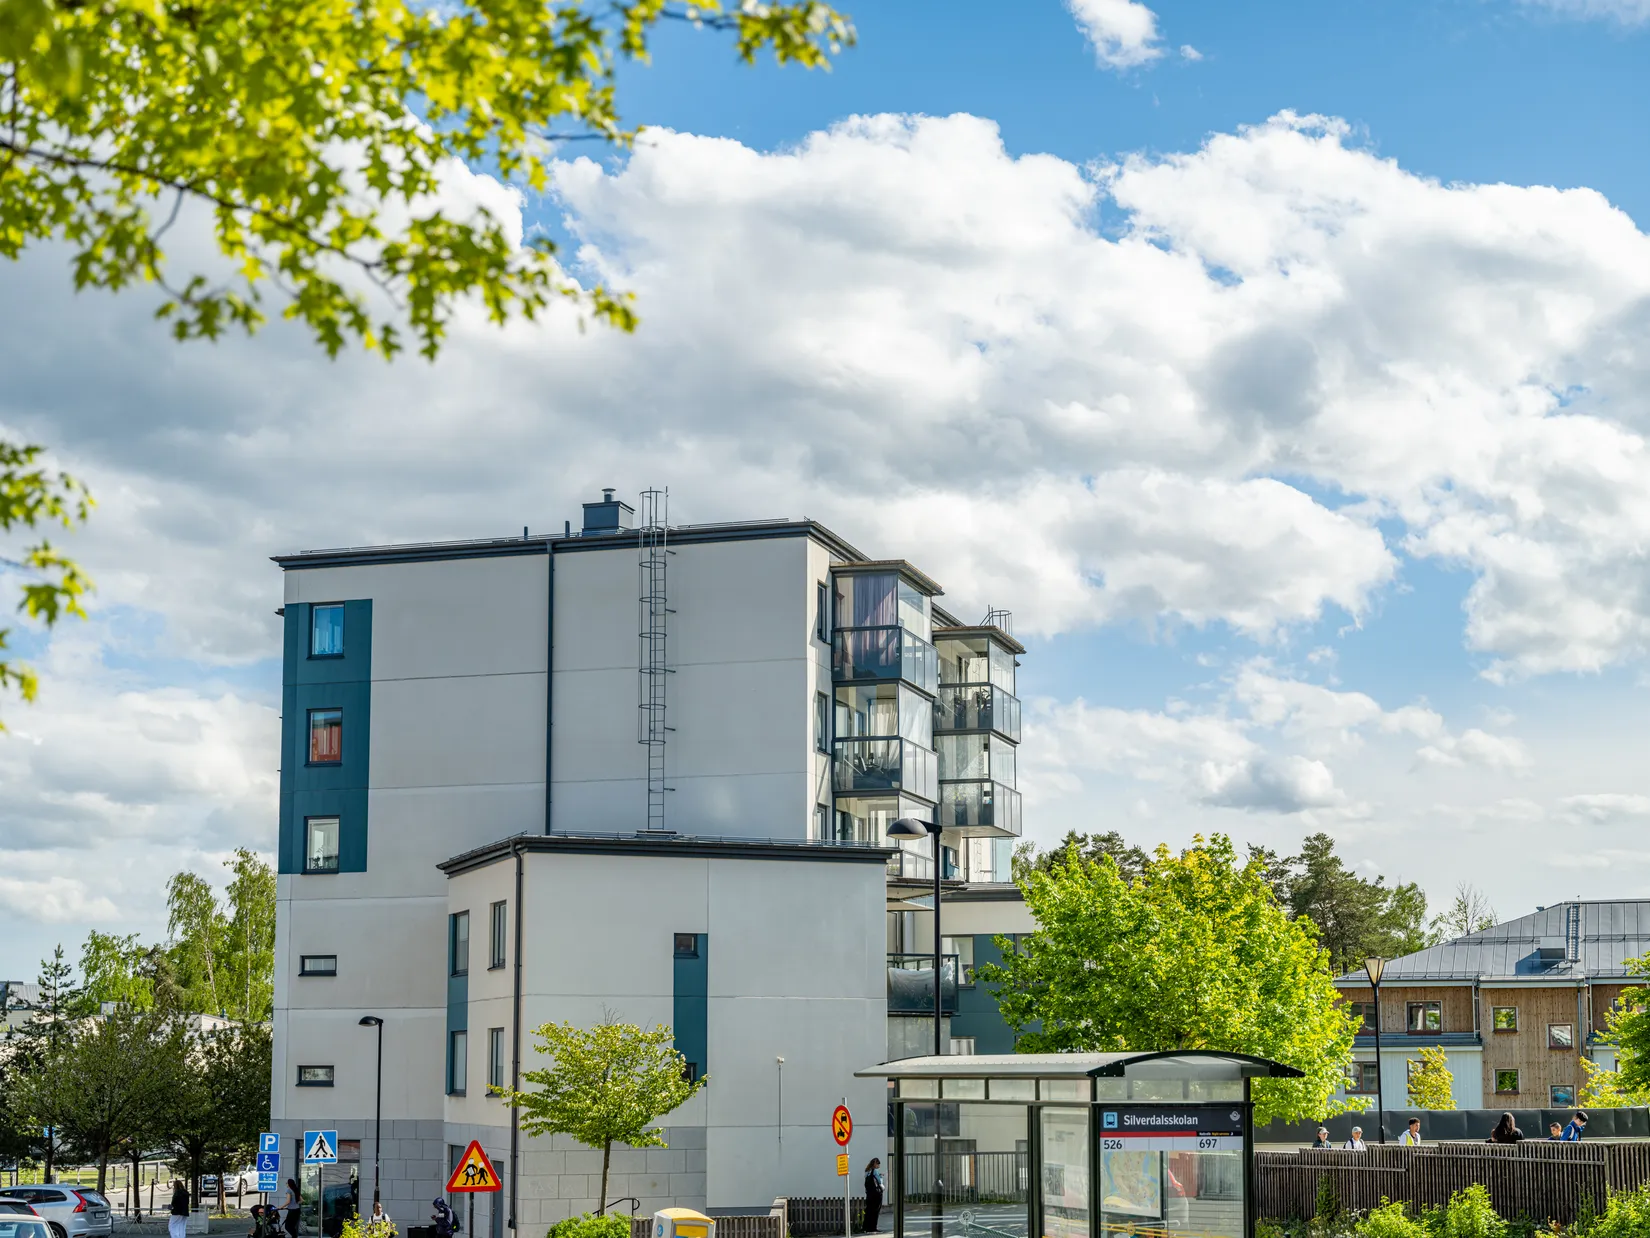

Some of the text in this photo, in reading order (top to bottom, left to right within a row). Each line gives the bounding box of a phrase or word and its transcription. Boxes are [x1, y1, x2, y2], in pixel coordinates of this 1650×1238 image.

[1123, 1114, 1199, 1126] Silverdalsskolan
[265, 1135, 276, 1150] P
[1103, 1139, 1123, 1150] 526
[1199, 1138, 1218, 1149] 697
